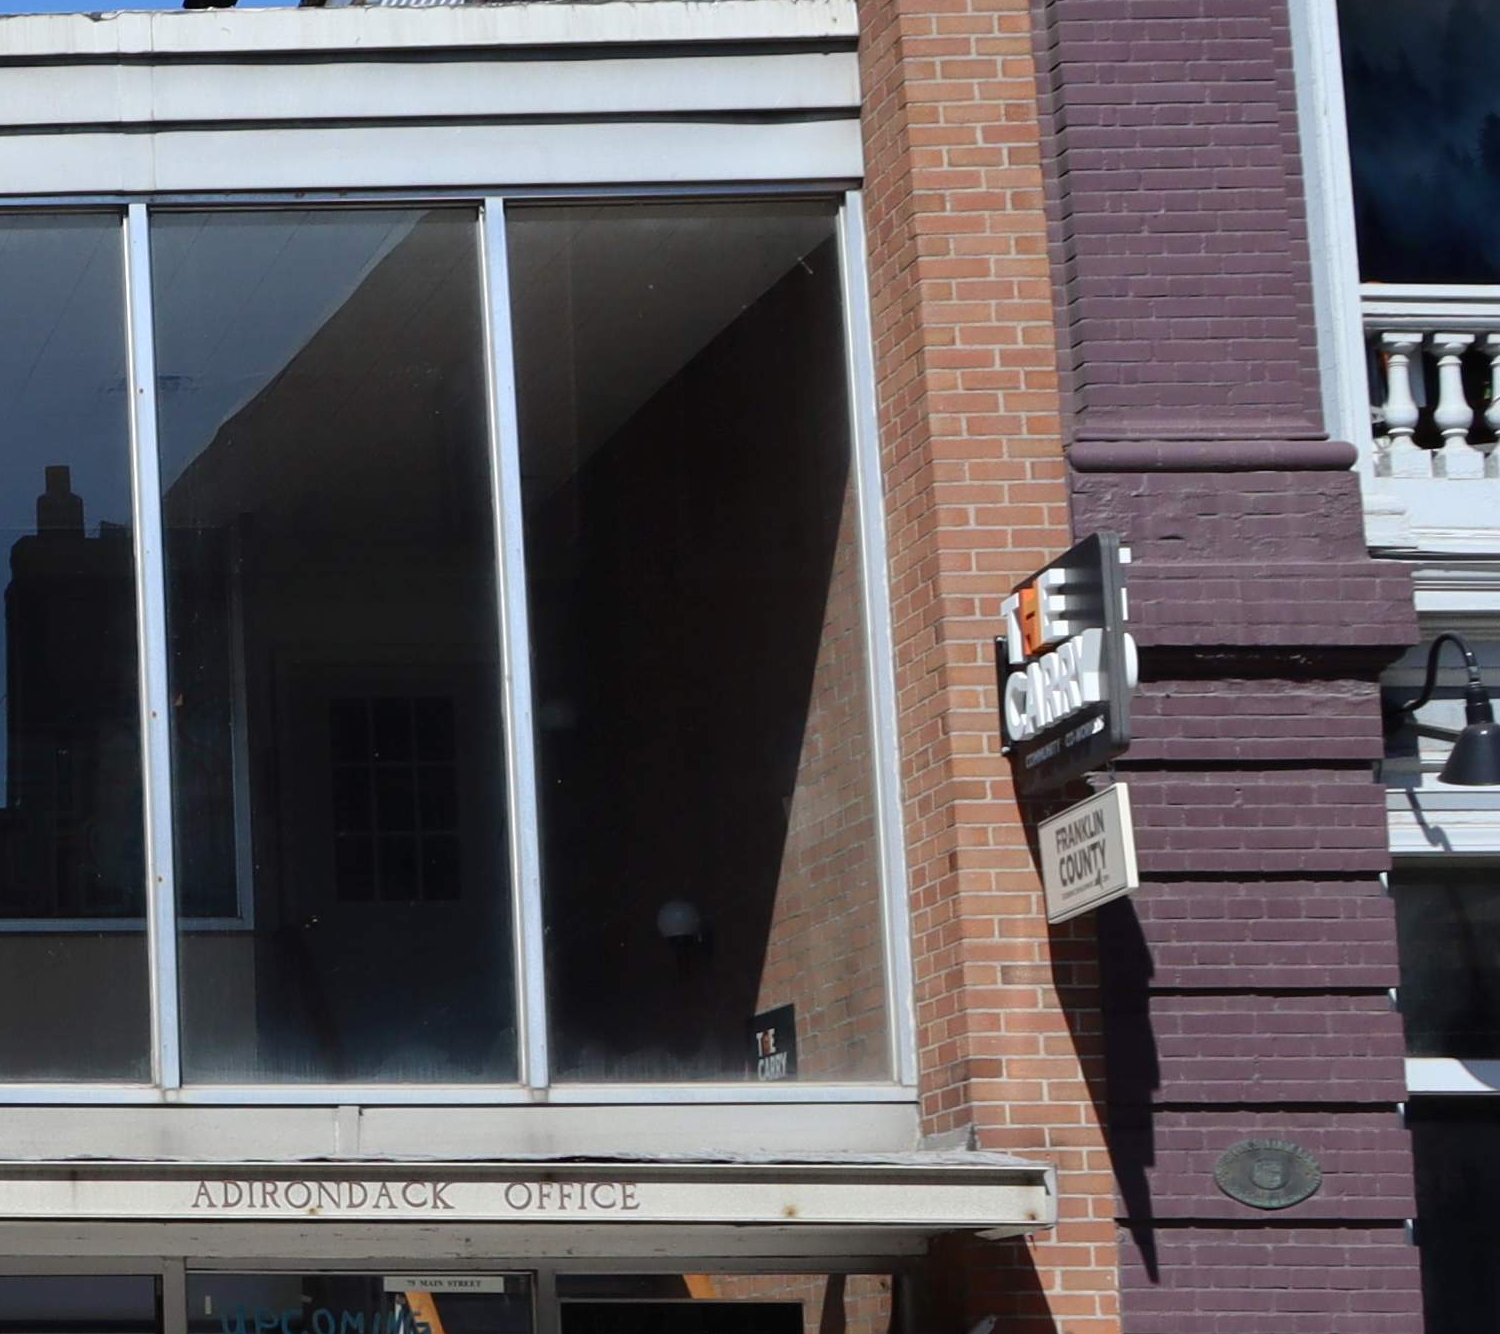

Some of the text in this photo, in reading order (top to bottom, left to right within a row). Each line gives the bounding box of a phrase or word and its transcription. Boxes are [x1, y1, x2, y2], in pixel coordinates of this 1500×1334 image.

[1000, 567, 1068, 665] THE
[1004, 627, 1106, 743] CARRY
[1055, 809, 1106, 854] FRANKLIN
[1059, 838, 1106, 887] COUNTY
[192, 1180, 641, 1211] ADIRONDACK OFFICE
[420, 1279, 443, 1288] MAIN
[447, 1279, 481, 1288] STREET
